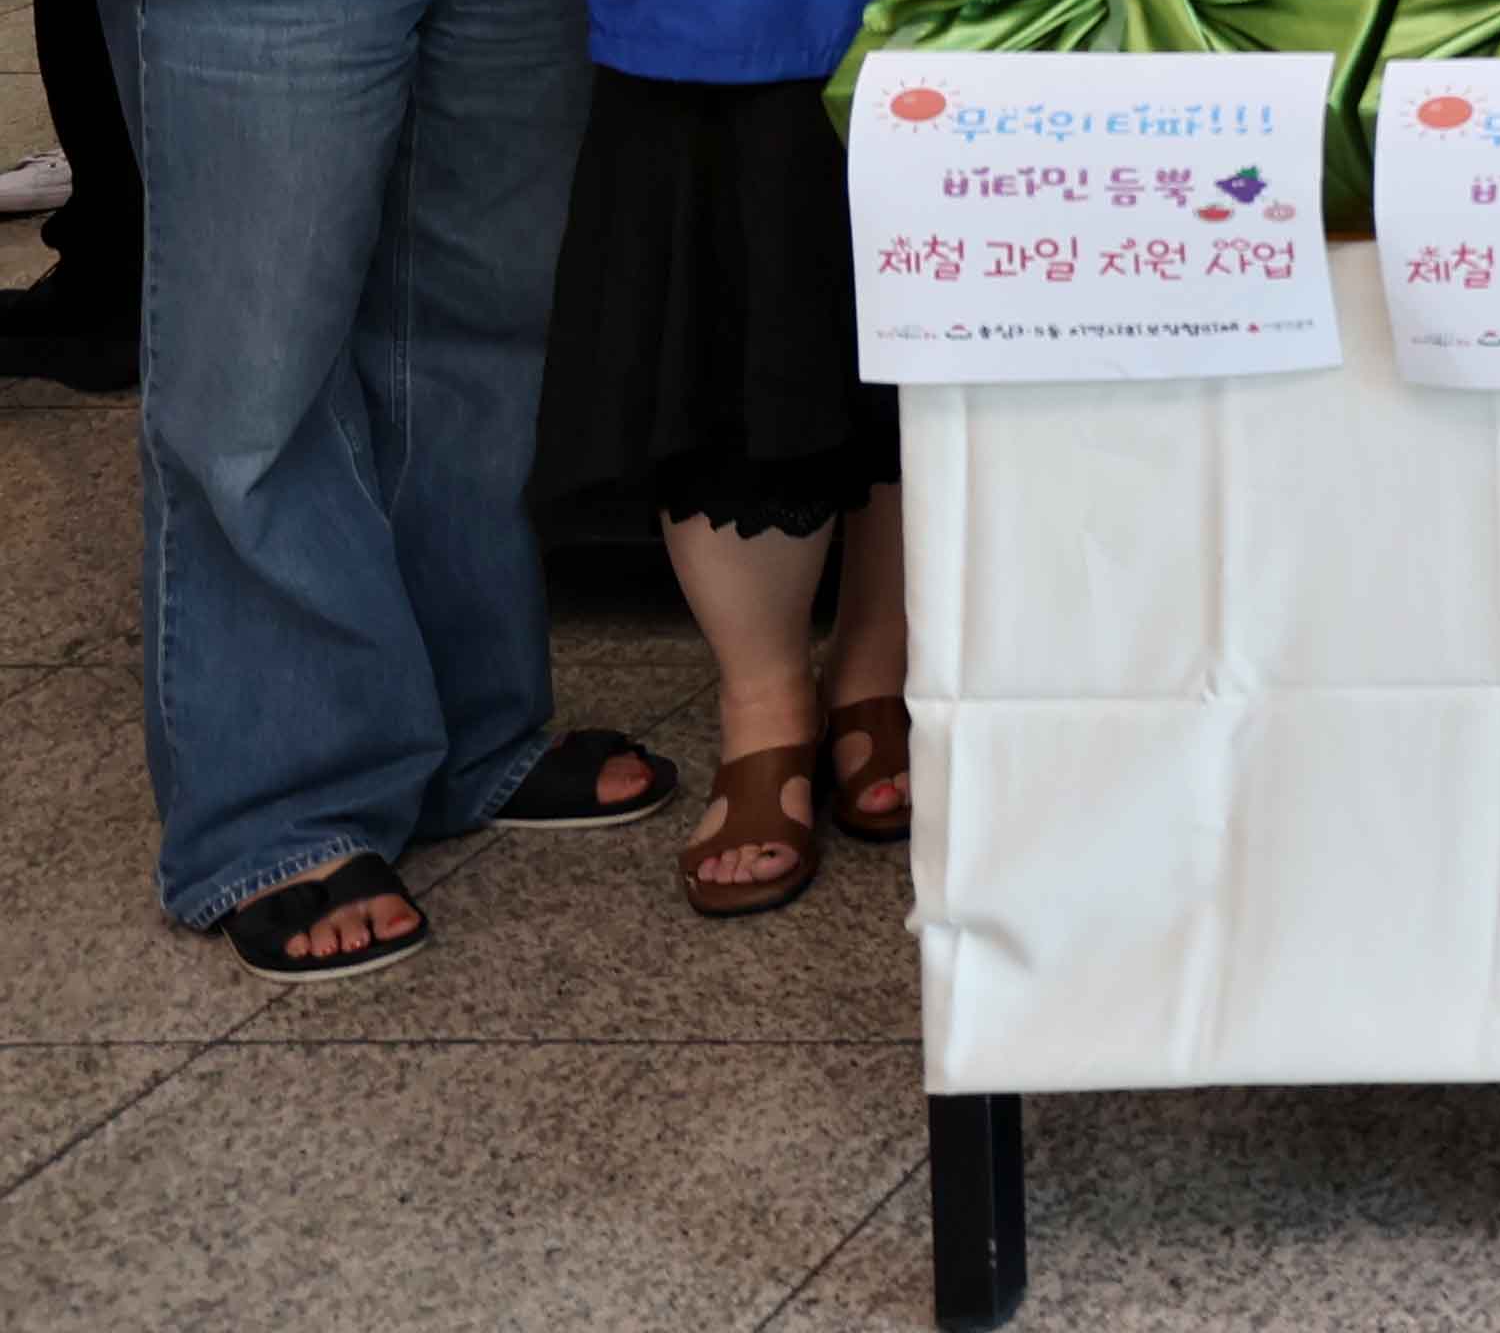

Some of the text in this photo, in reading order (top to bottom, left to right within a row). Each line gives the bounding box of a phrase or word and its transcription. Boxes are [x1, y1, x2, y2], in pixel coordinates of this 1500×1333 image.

[951, 102, 1276, 143] 무더위 타파!!!
[943, 166, 1091, 203] 비타민
[877, 234, 1297, 282] 제철 과일 지원 사업
[1405, 240, 1496, 291] 제철
